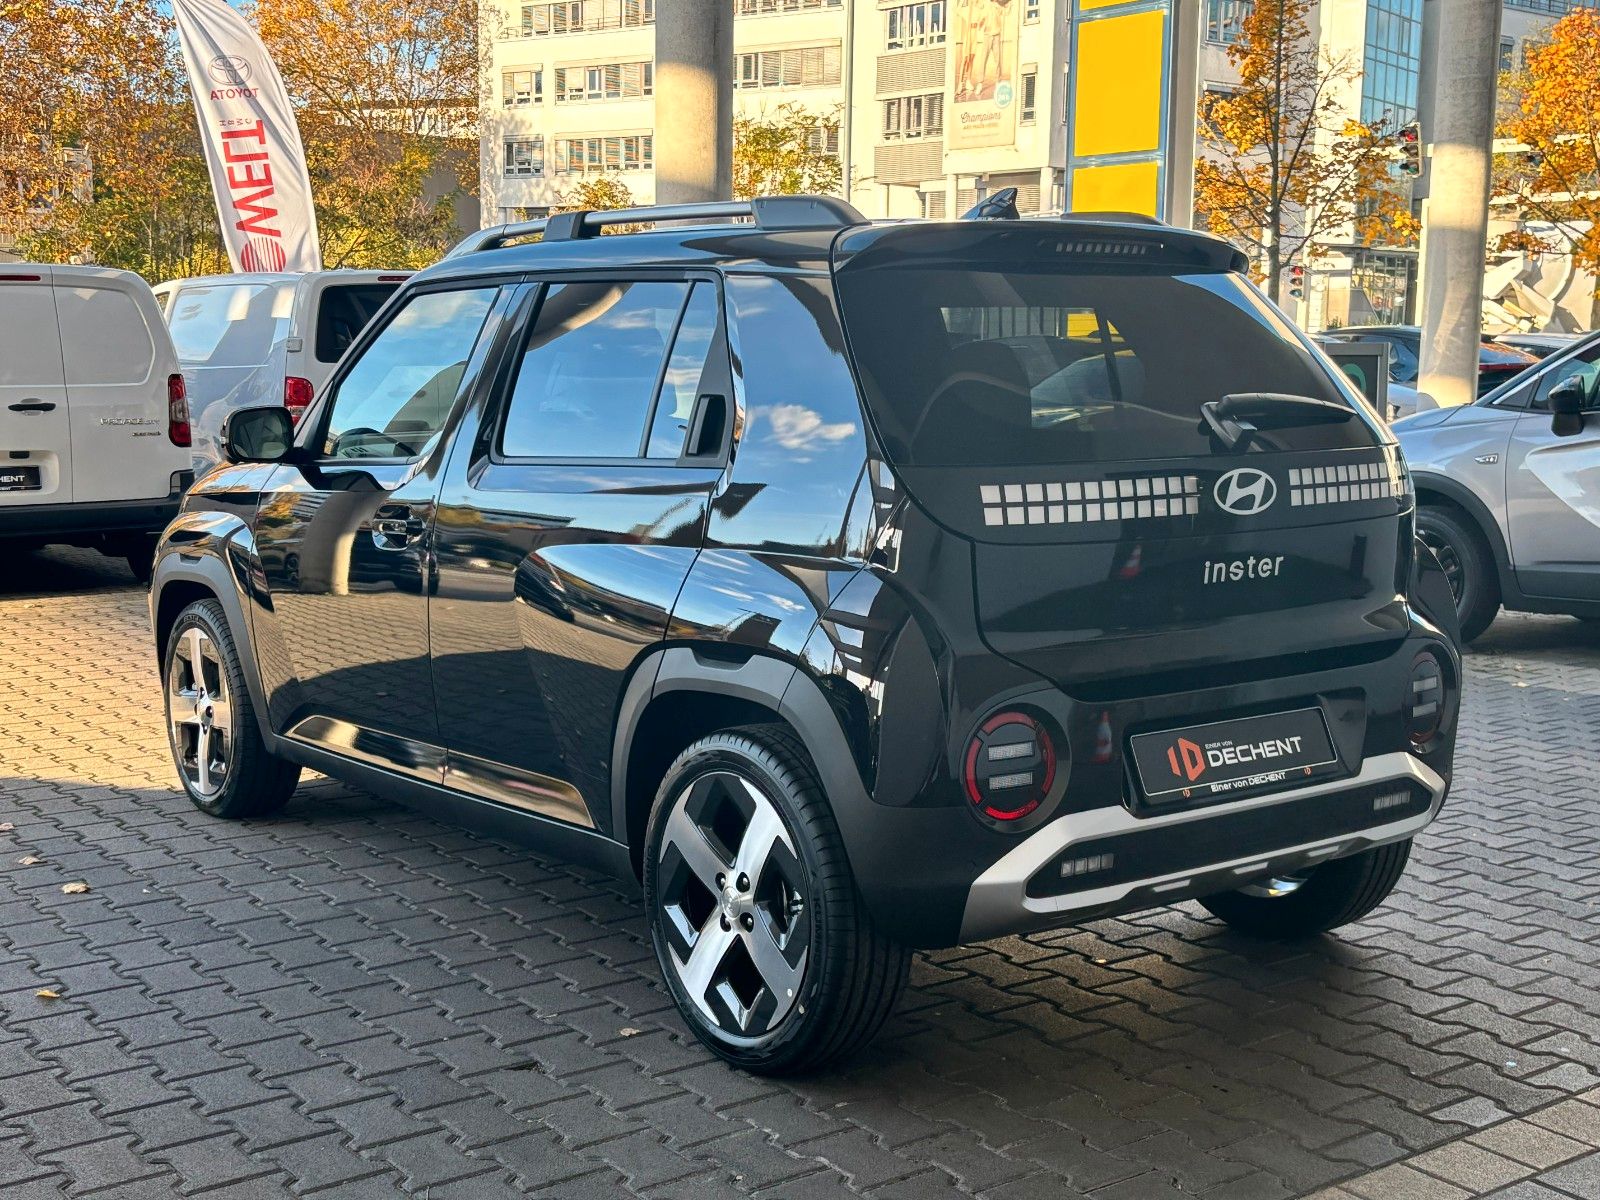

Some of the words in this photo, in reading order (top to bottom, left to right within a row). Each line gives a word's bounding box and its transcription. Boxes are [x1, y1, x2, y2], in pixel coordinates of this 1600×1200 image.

[1203, 555, 1284, 585] inster
[1206, 736, 1302, 768] DECHENT
[1210, 783, 1232, 793] Einer
[1232, 780, 1248, 789] von
[1248, 772, 1286, 786] DECHENT
